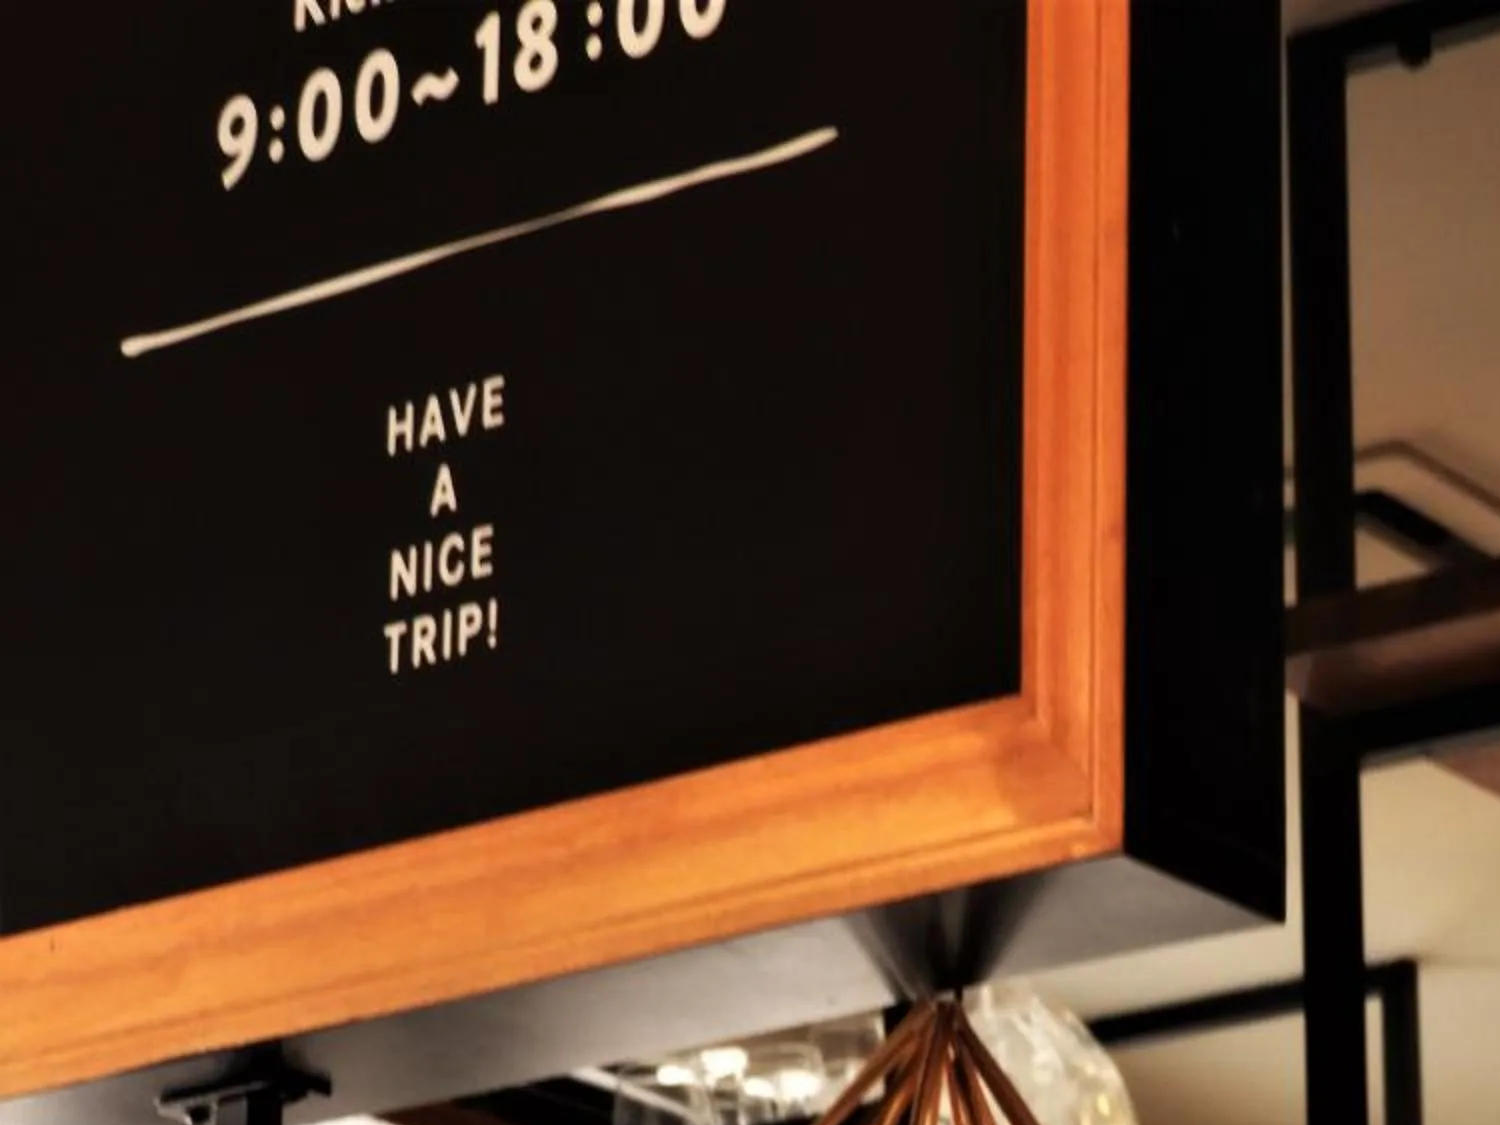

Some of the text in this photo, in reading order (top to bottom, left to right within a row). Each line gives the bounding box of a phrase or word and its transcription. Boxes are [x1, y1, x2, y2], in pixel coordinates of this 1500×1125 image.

[386, 375, 506, 456] HAVE
[430, 463, 458, 517] A
[390, 524, 495, 601] NICE
[383, 598, 499, 674] TRIP!
